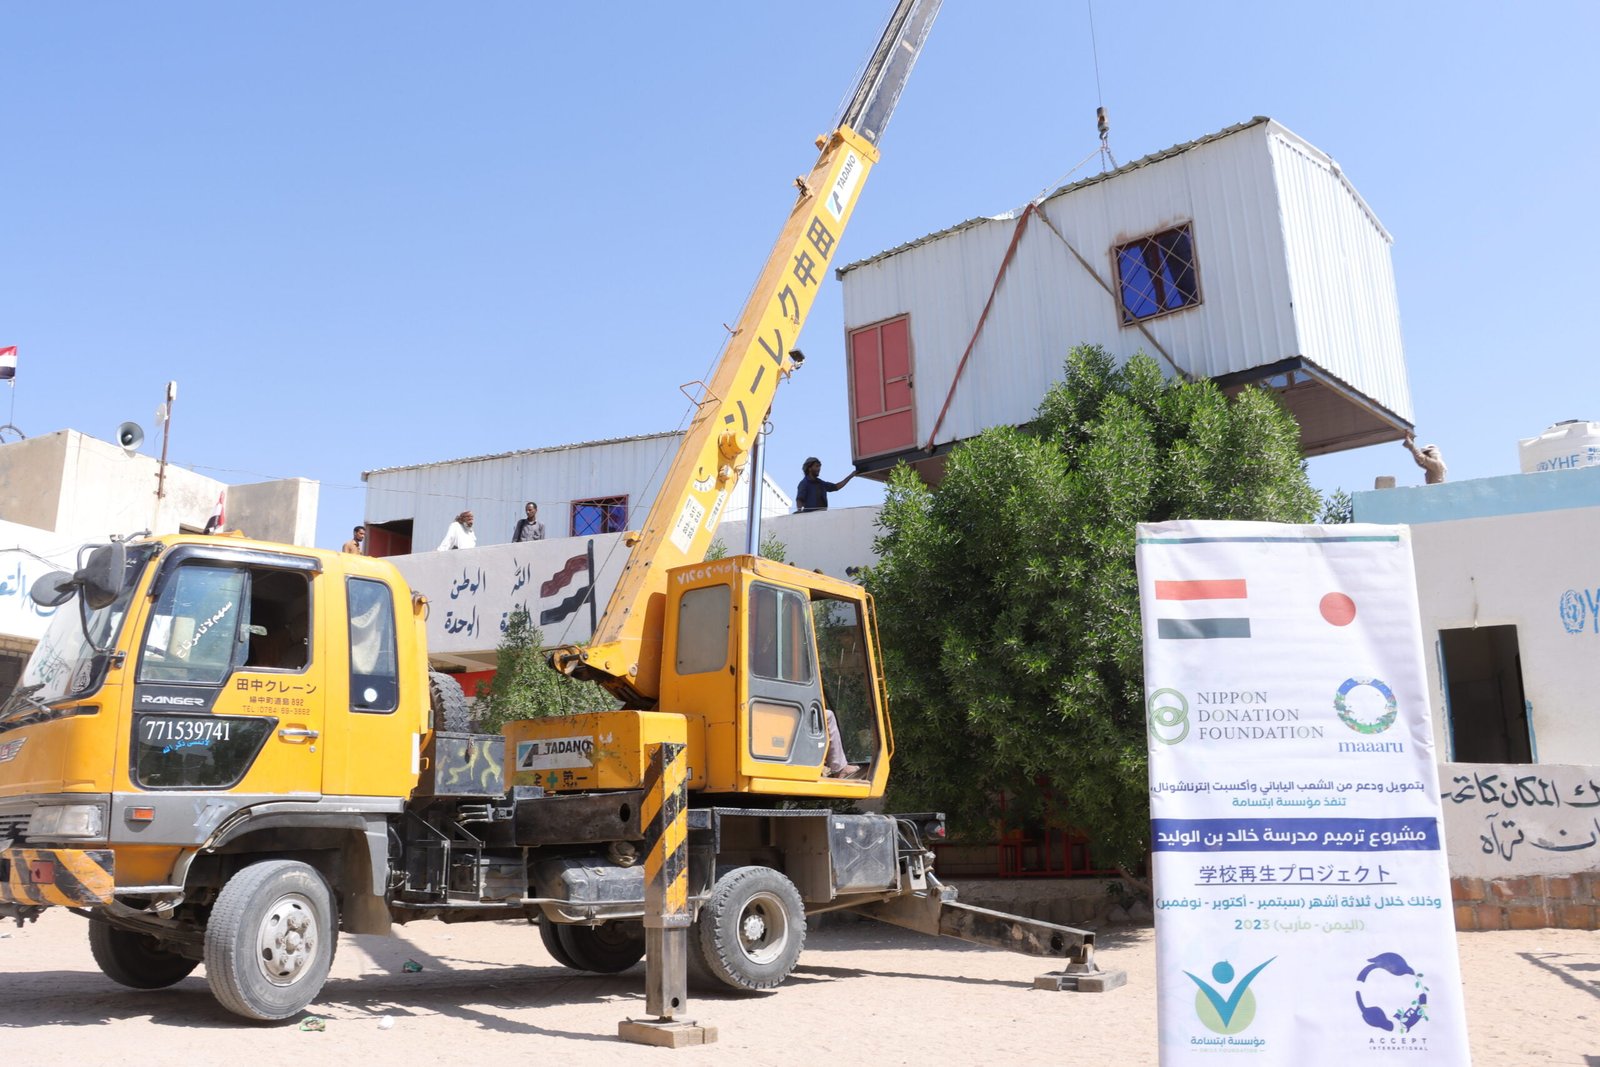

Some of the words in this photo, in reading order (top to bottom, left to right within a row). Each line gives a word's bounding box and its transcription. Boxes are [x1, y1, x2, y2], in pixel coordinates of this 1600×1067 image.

[836, 154, 856, 190] TADANO
[724, 215, 835, 434] 田中クレーン
[1547, 454, 1580, 470] YHF
[450, 567, 486, 600] الوطن
[444, 604, 480, 639] الوحدة
[236, 678, 317, 694] 田中クレーン
[141, 695, 205, 706] RANGER
[1197, 691, 1268, 705] NIPPON
[1198, 709, 1299, 723] DONATION
[145, 721, 230, 741] 771539741
[1199, 726, 1324, 740] FOUNDATION
[543, 740, 590, 755] TADANO
[1338, 741, 1405, 753] maaaru
[1212, 779, 1258, 793] وأكسبت
[1259, 780, 1295, 796] الياباني
[1296, 778, 1334, 791] الشعب
[1336, 780, 1353, 792] من
[1355, 781, 1384, 793] ودعم
[1386, 780, 1425, 793] بتمويل
[1232, 797, 1274, 809] ابتسامة
[1276, 797, 1321, 808] مؤسسة
[1157, 830, 1201, 847] الوليد
[1203, 832, 1224, 846] بن
[1226, 828, 1260, 842] خالد
[1262, 827, 1318, 845] مدرسة
[1322, 829, 1366, 846] ترميم
[1369, 825, 1427, 847] مشروع
[1199, 864, 1390, 883] 学校再生プロジェクト
[1212, 895, 1247, 911] أكتوبر
[1308, 894, 1339, 910] أشهر
[1341, 894, 1371, 908] ثلاثة
[1374, 896, 1405, 909] خلال
[1407, 896, 1442, 909] وذلك
[1235, 919, 1270, 931] 2023
[1190, 1036, 1226, 1048] ابتسامة
[1228, 1036, 1266, 1048] مؤسسة
[1369, 1037, 1427, 1045] ACCEPT
